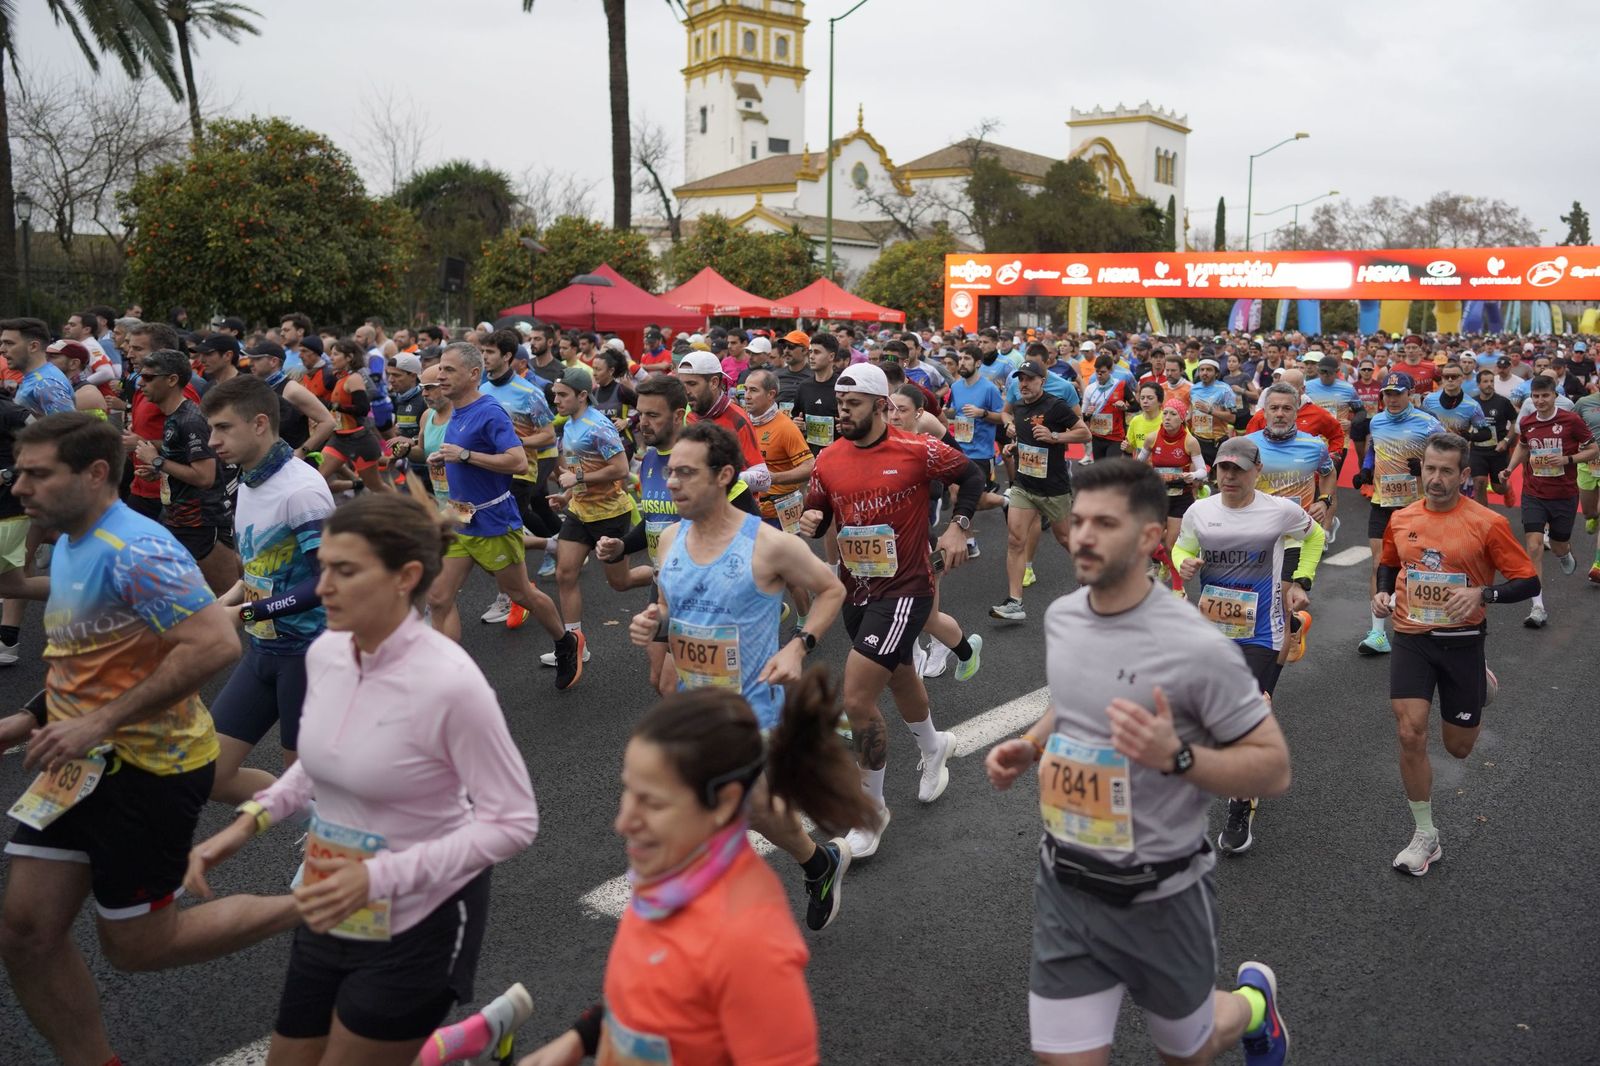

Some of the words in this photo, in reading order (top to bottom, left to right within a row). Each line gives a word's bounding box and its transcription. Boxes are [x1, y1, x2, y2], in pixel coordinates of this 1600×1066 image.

[1356, 264, 1412, 283] HOKA
[1386, 482, 1408, 493] 4391
[845, 539, 882, 555] 7875
[1207, 599, 1242, 618] 7138
[677, 639, 719, 665] 7687
[1050, 761, 1100, 803] 7841
